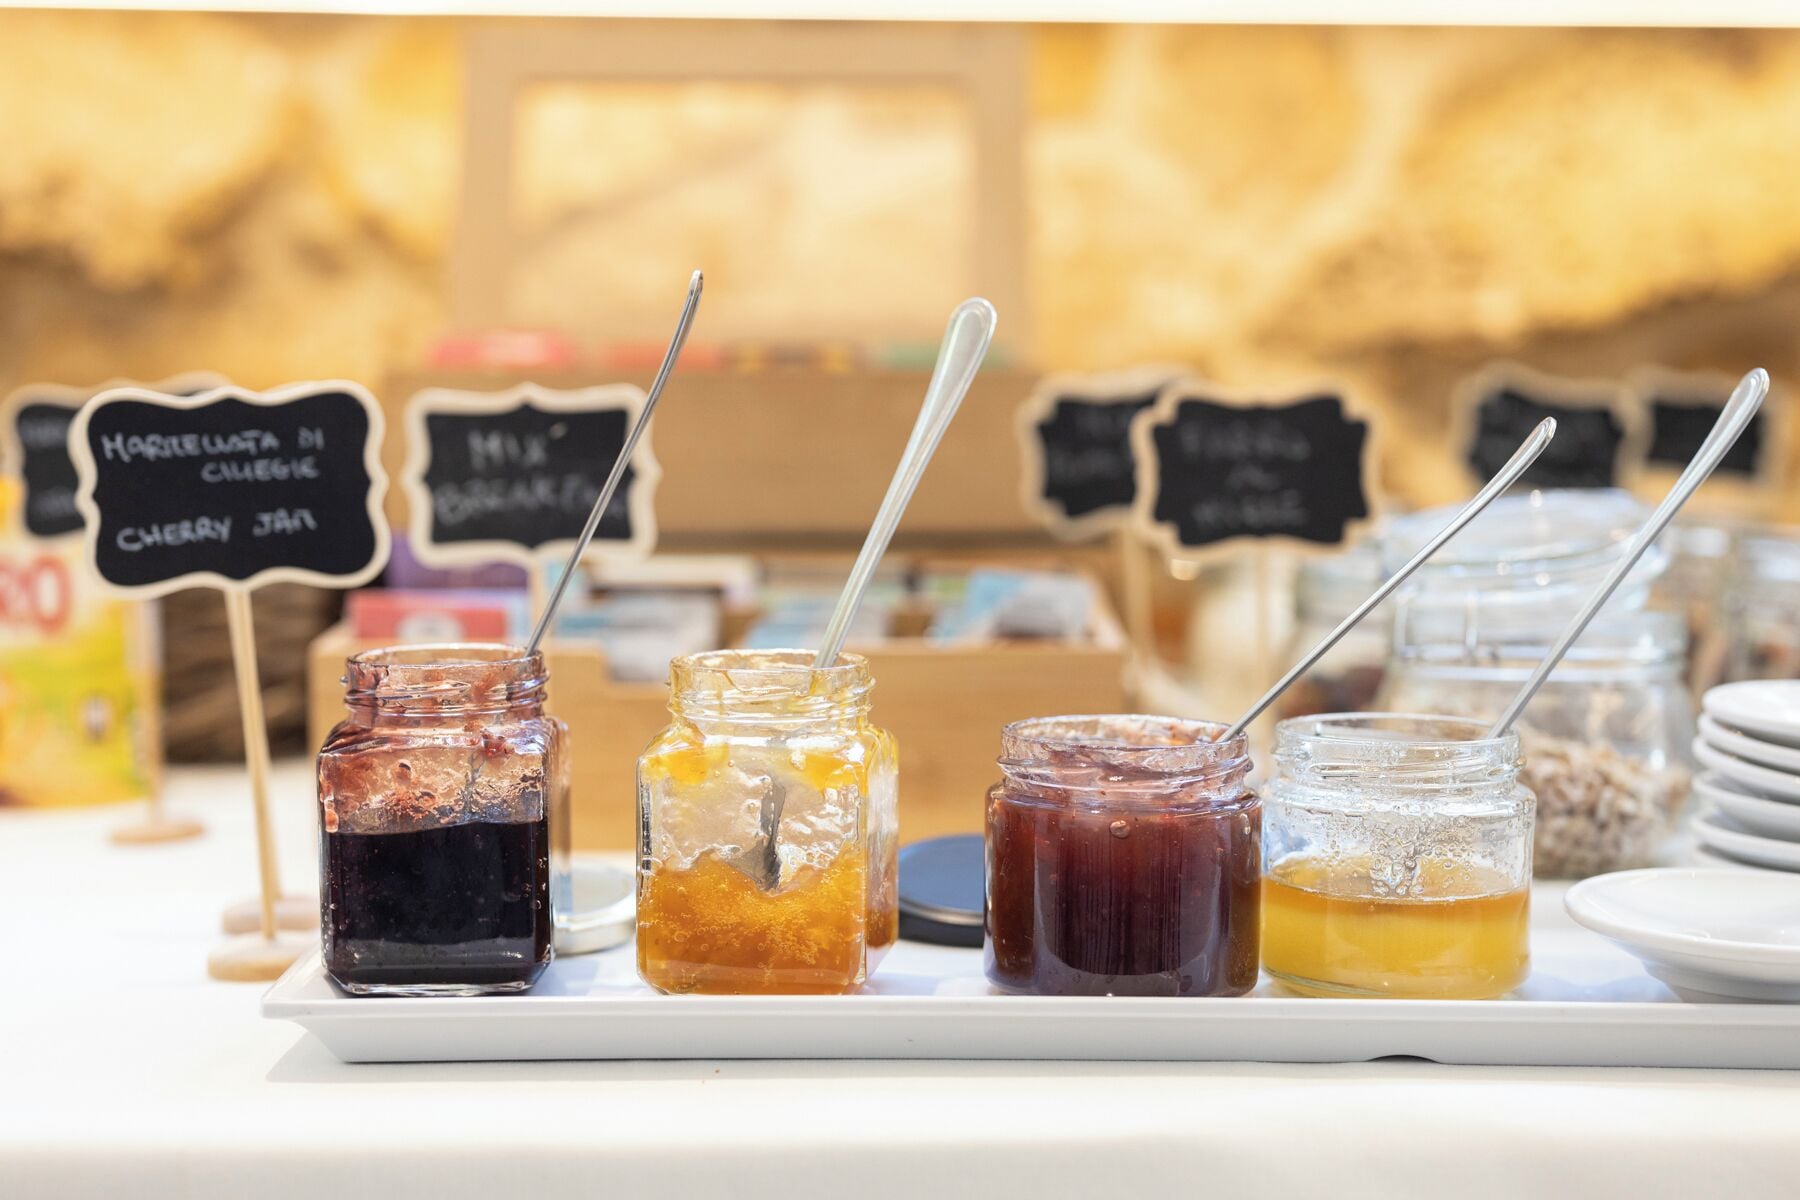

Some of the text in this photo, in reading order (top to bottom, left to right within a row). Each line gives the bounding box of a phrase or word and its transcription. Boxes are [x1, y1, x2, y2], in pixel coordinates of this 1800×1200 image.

[298, 426, 324, 451] DI
[116, 508, 318, 552] CHERRY JAM
